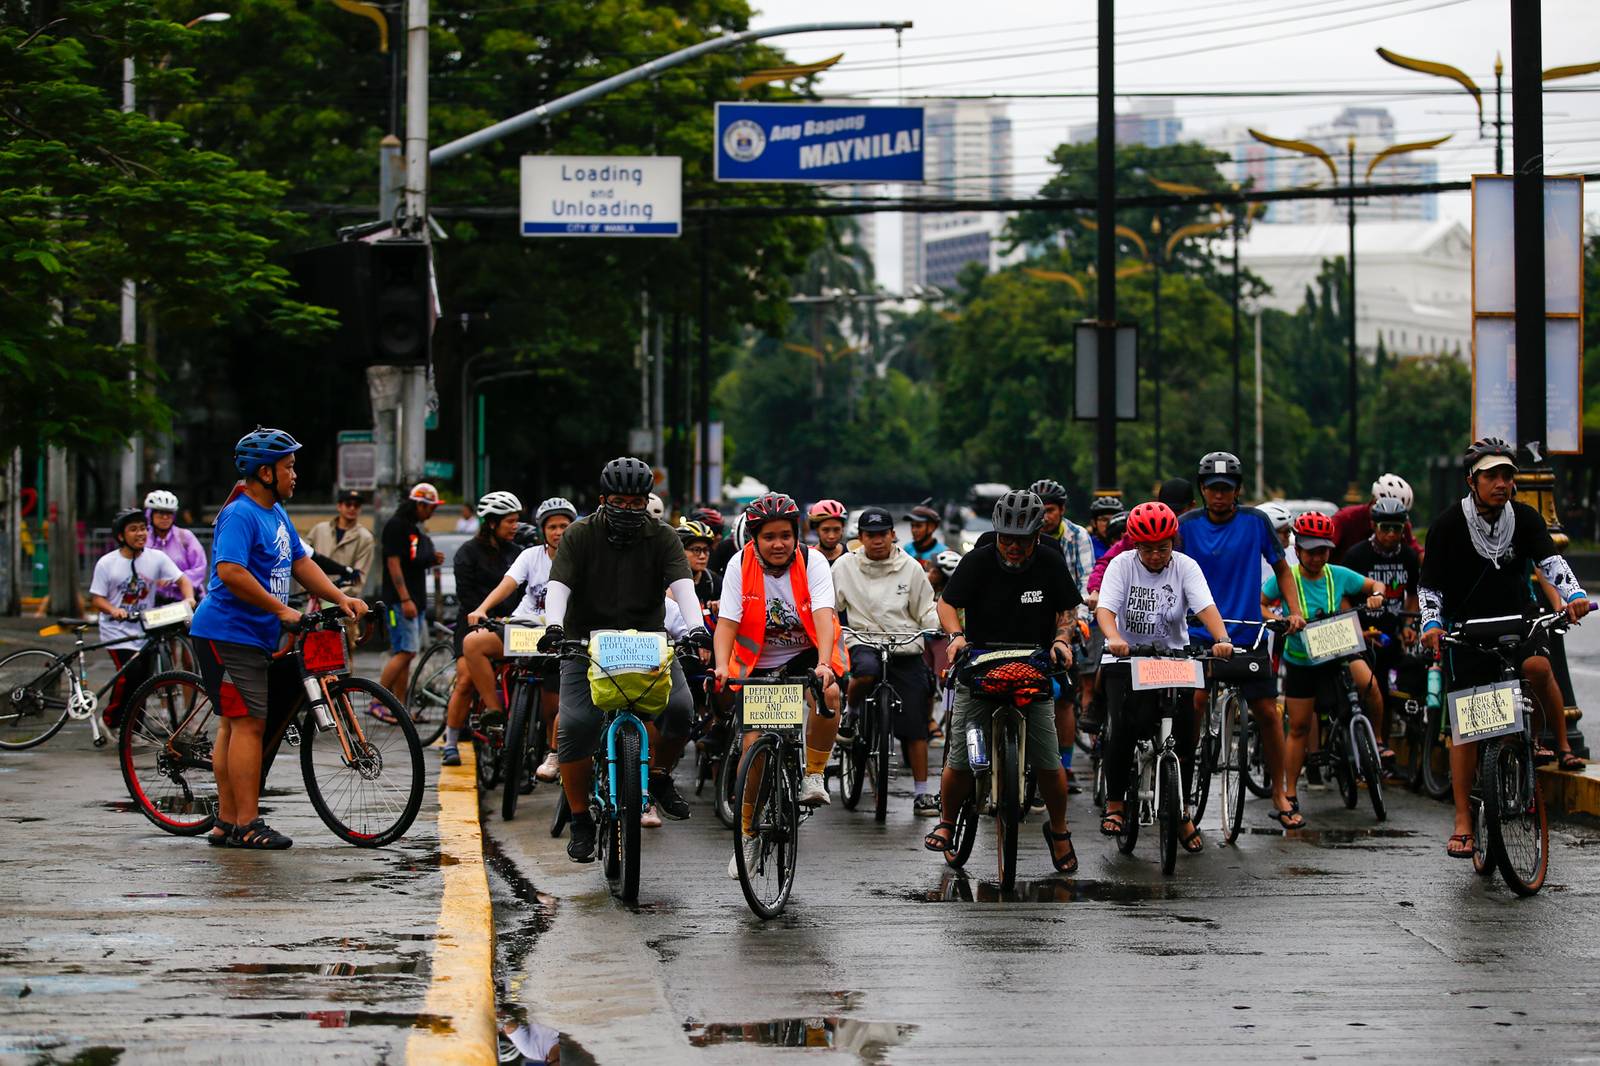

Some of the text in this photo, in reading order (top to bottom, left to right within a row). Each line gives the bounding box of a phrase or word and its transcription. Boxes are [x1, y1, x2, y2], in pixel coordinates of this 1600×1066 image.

[770, 124, 802, 142] Ang
[804, 114, 866, 138] Bagong
[800, 128, 920, 170] MAYNILA!
[562, 165, 643, 186] Loading
[590, 188, 614, 200] and
[552, 200, 653, 220] Unloading
[567, 224, 636, 232] CITY OF MANILA
[1130, 586, 1155, 599] PEOPLE
[1127, 598, 1156, 612] PLANET
[1126, 610, 1145, 622] OVER
[1126, 621, 1156, 634] PROFIT
[606, 654, 653, 663] RESOURCES!
[745, 695, 801, 704] PEOPLE, LAND,
[1466, 692, 1502, 706] TUBIG SA
[750, 712, 797, 720] RESOURCES!
[1468, 711, 1489, 722] HINDI
